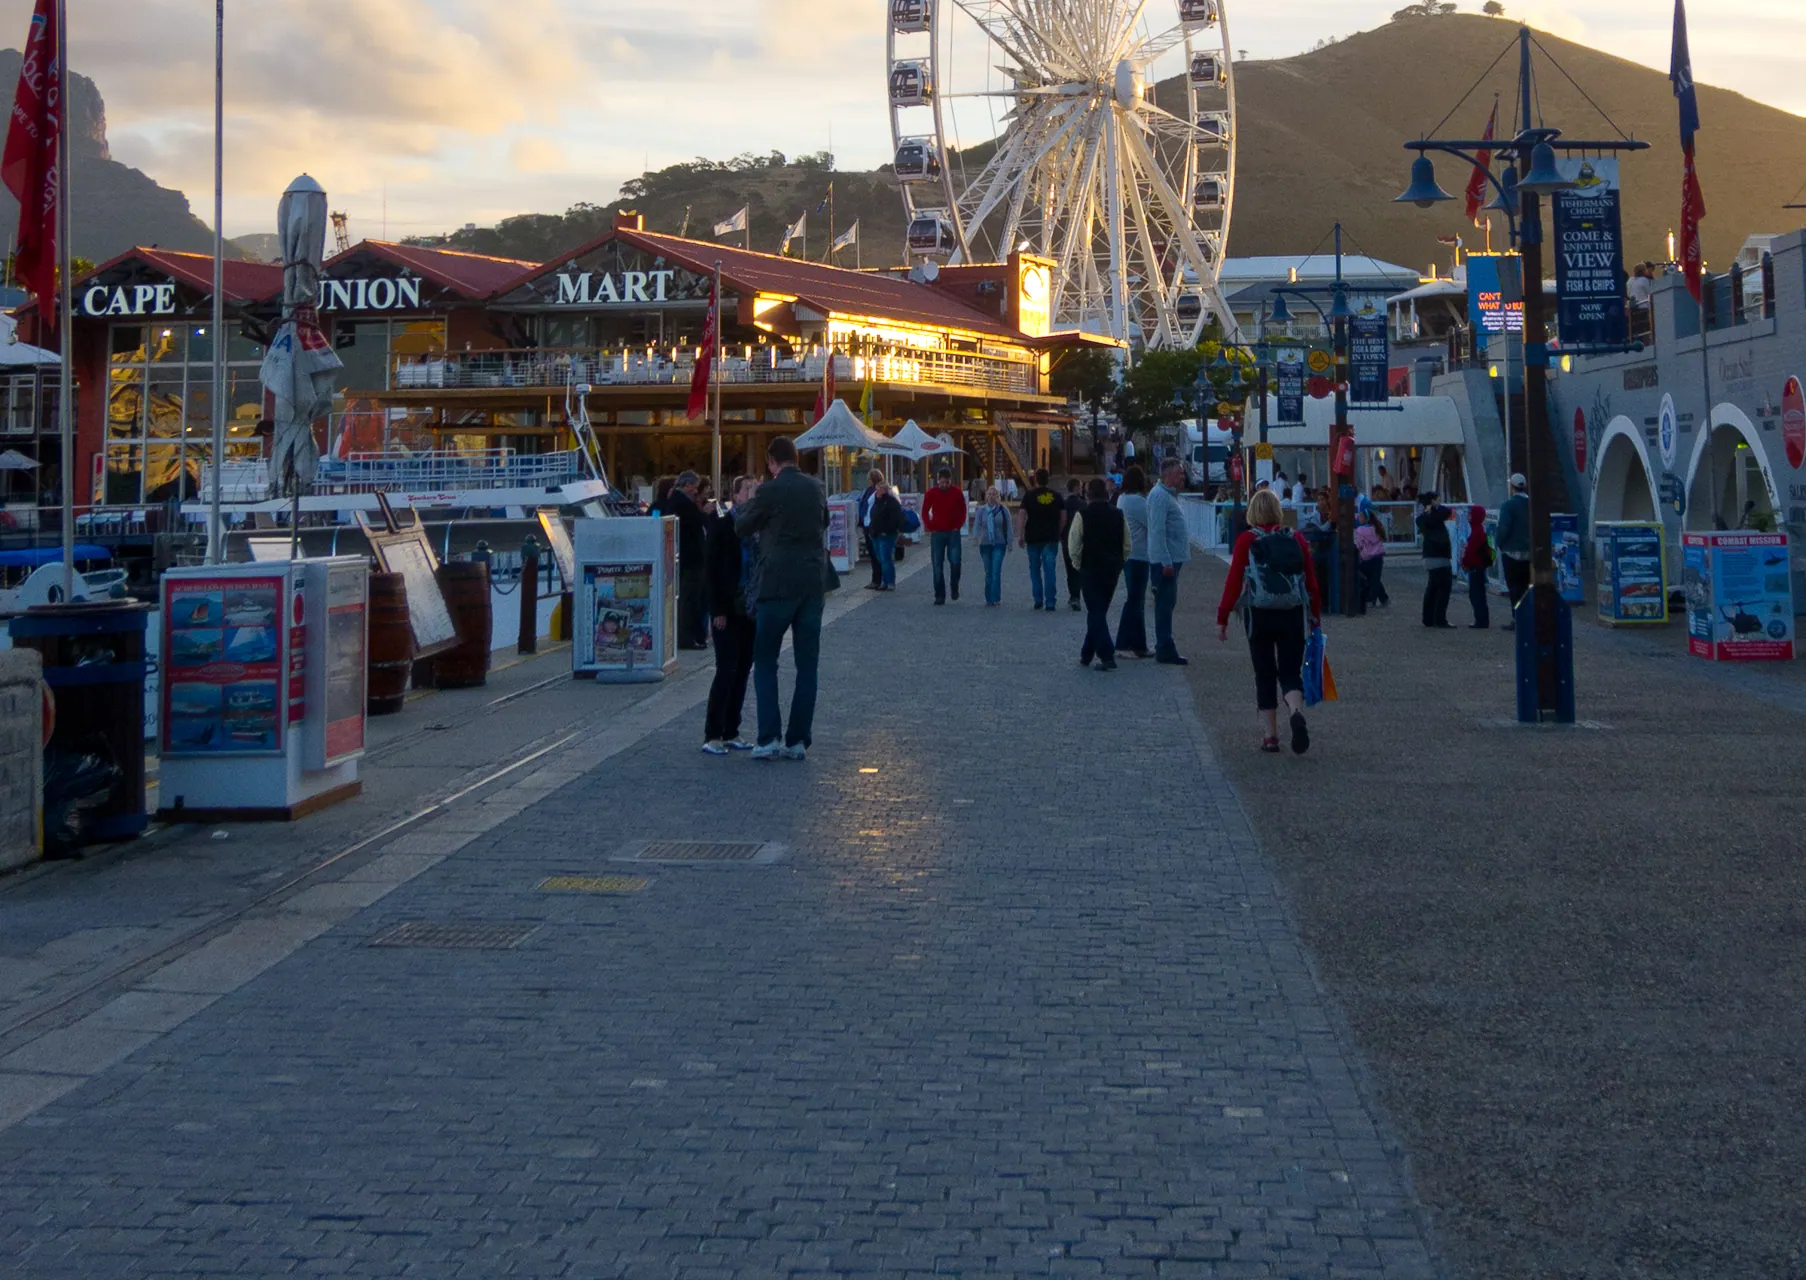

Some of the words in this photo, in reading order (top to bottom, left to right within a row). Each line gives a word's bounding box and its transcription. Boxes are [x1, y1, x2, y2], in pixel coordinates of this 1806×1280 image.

[1560, 200, 1614, 208] FISHERMANS
[1563, 231, 1600, 241] COME
[1602, 231, 1613, 241] &
[1563, 242, 1592, 252] ENJOY
[1594, 242, 1615, 251] THE
[1563, 252, 1616, 268] VIEW
[556, 270, 674, 304] MART
[1565, 280, 1584, 292] FISH
[1584, 280, 1591, 291] &
[1592, 279, 1615, 291] CHIPS
[84, 284, 176, 316] CAPE
[1478, 292, 1502, 301] CAN'T
[1478, 301, 1501, 310] WHAT
[1578, 312, 1605, 320] OPEN!
[1717, 536, 1747, 545] COMBAT
[1749, 536, 1781, 545] MISSION
